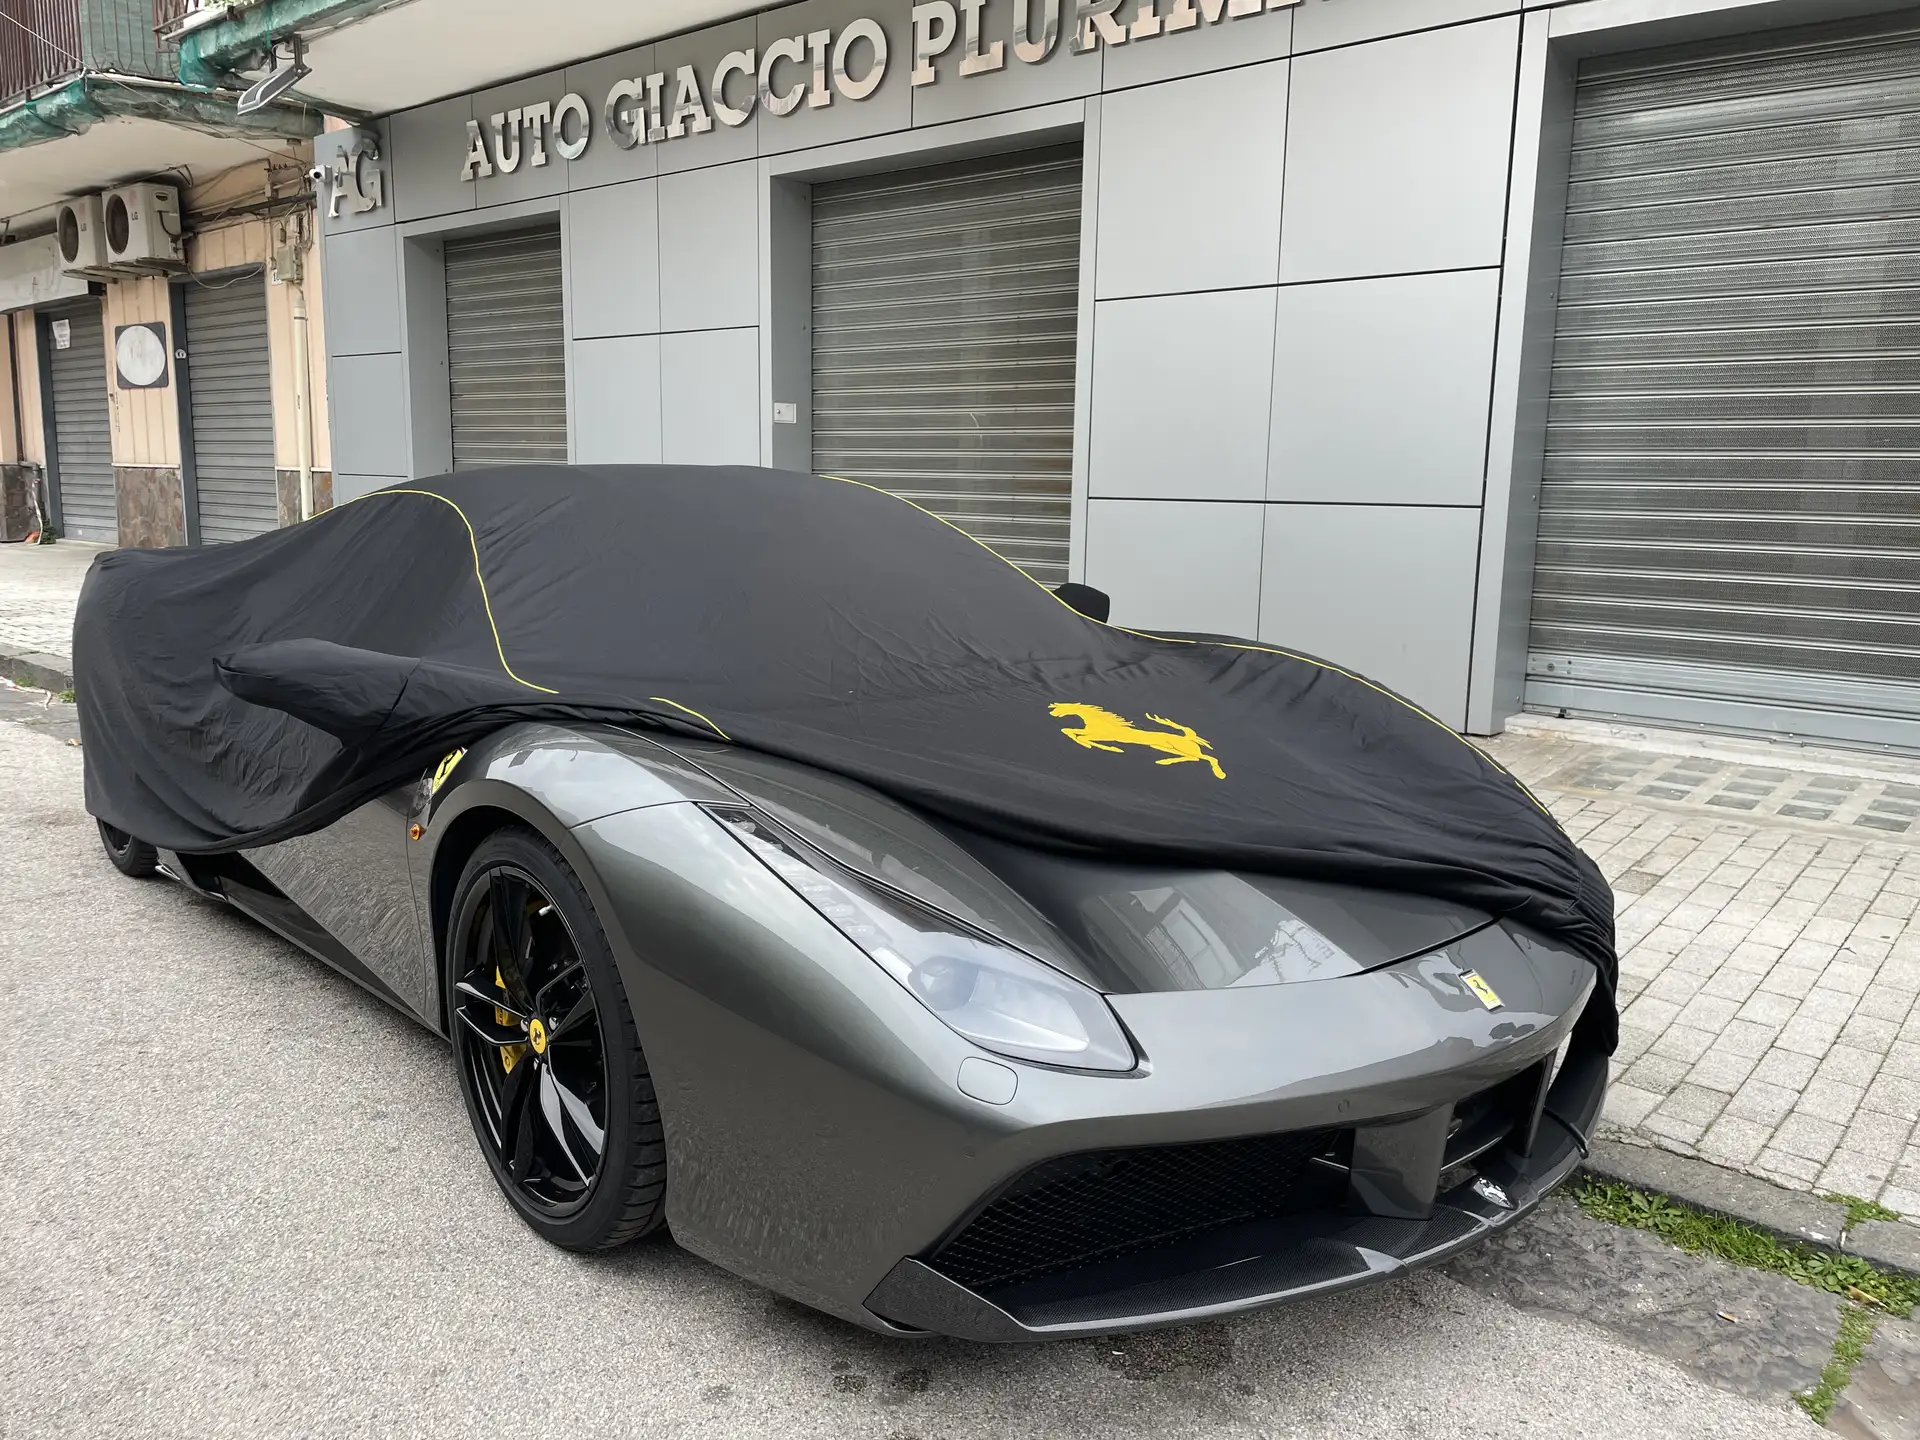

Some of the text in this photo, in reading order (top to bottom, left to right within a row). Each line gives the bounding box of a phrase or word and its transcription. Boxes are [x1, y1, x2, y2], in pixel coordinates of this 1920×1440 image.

[461, 93, 590, 182] AUTO
[605, 18, 888, 150] GIACCIO
[131, 211, 139, 221] LG
[328, 138, 382, 217] AG
